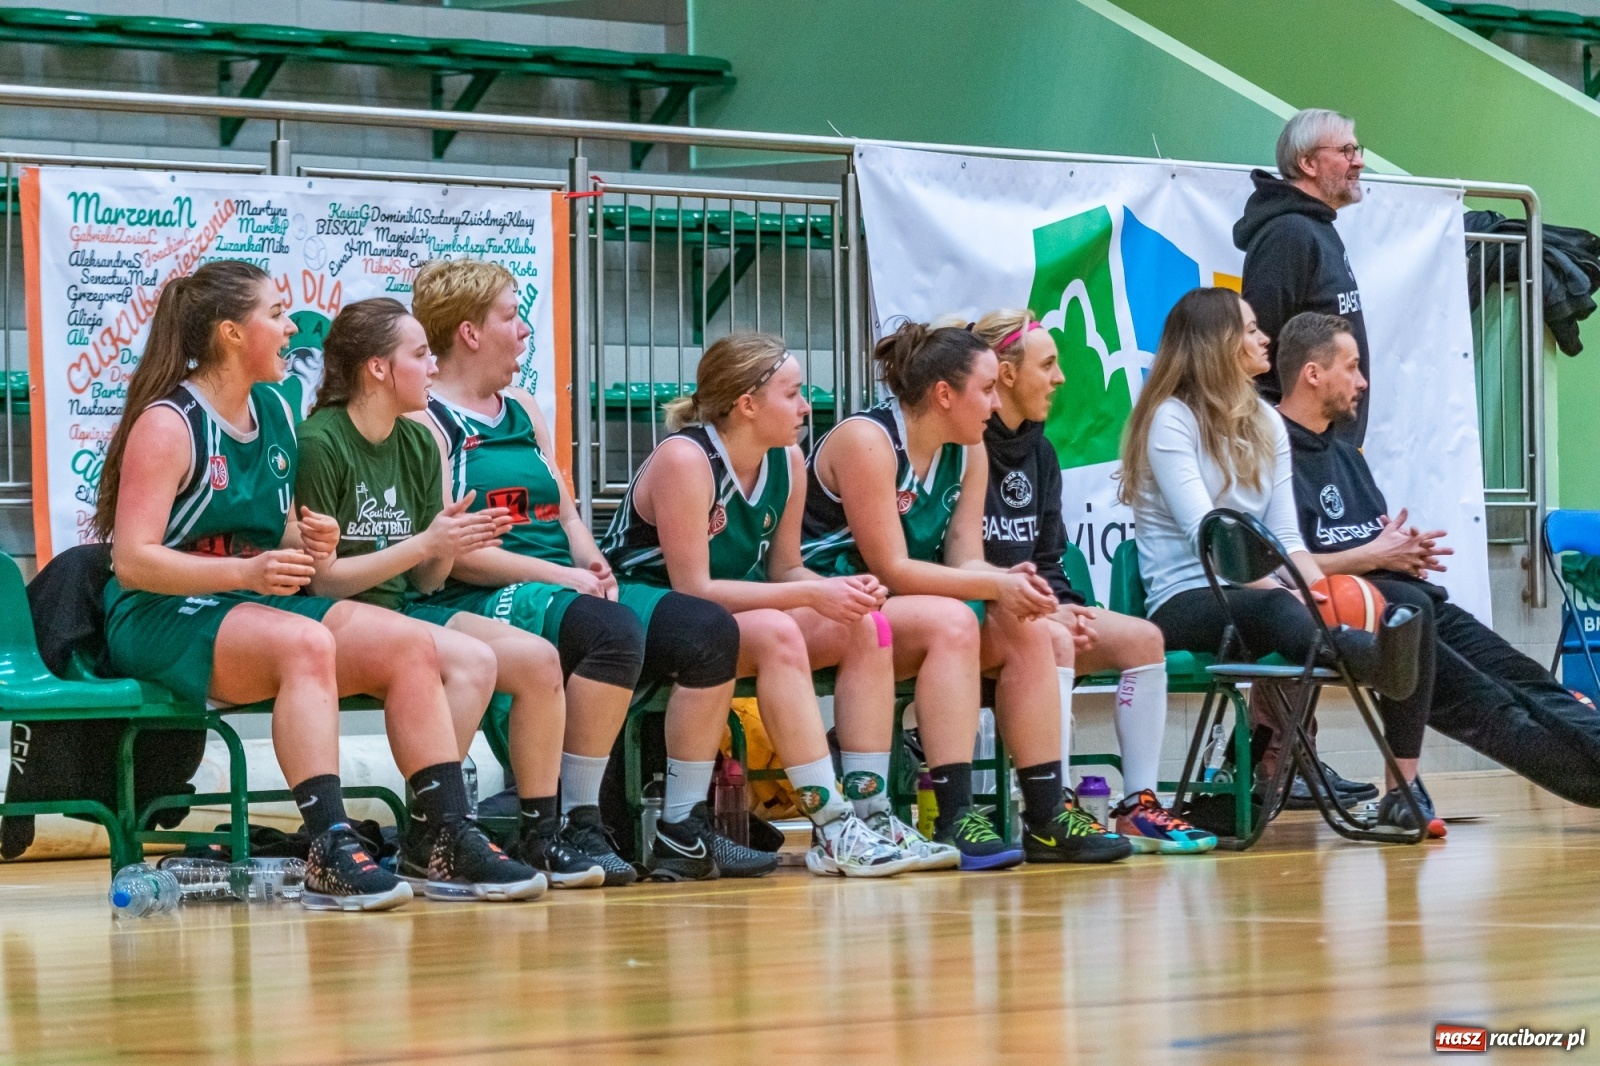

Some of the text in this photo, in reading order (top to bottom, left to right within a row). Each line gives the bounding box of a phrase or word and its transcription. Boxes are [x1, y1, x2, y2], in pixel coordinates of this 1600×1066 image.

[67, 191, 197, 229] MarzenaN
[234, 199, 288, 224] Martyna
[328, 202, 370, 227] KasiaG
[237, 217, 289, 236] MarekP
[316, 218, 363, 235] BISKU
[374, 226, 429, 245] MariolaH
[68, 249, 142, 269] AleksandraS
[357, 240, 409, 258] Maminka
[80, 268, 158, 286] SenectusMed
[67, 285, 133, 309] GrzegorzP
[302, 269, 342, 316] DLA
[67, 309, 103, 334] Alicja
[67, 329, 89, 346] Ala
